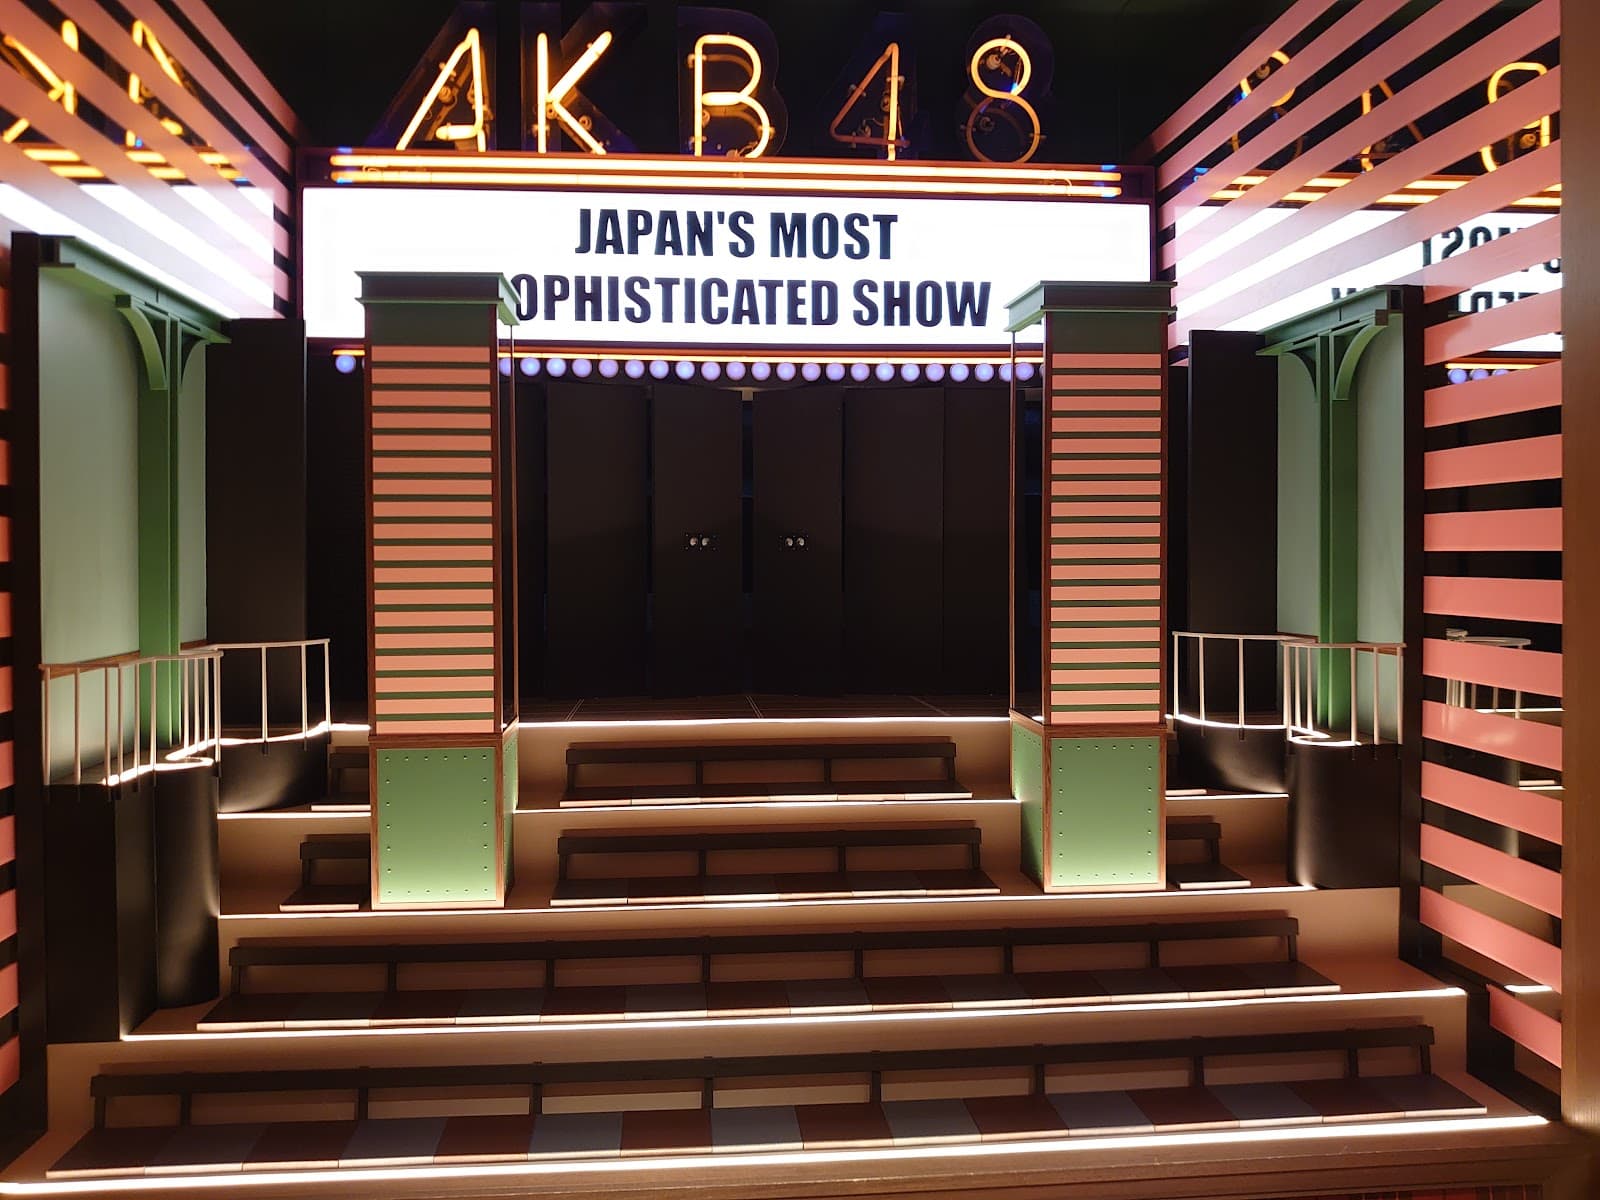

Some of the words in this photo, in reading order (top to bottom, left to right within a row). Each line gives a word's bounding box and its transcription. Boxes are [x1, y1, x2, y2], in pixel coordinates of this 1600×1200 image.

[574, 208, 755, 259] JAPAN'S
[769, 211, 899, 261] MOST
[510, 273, 839, 326] OPHISTICATED
[852, 278, 992, 328] SHOW
